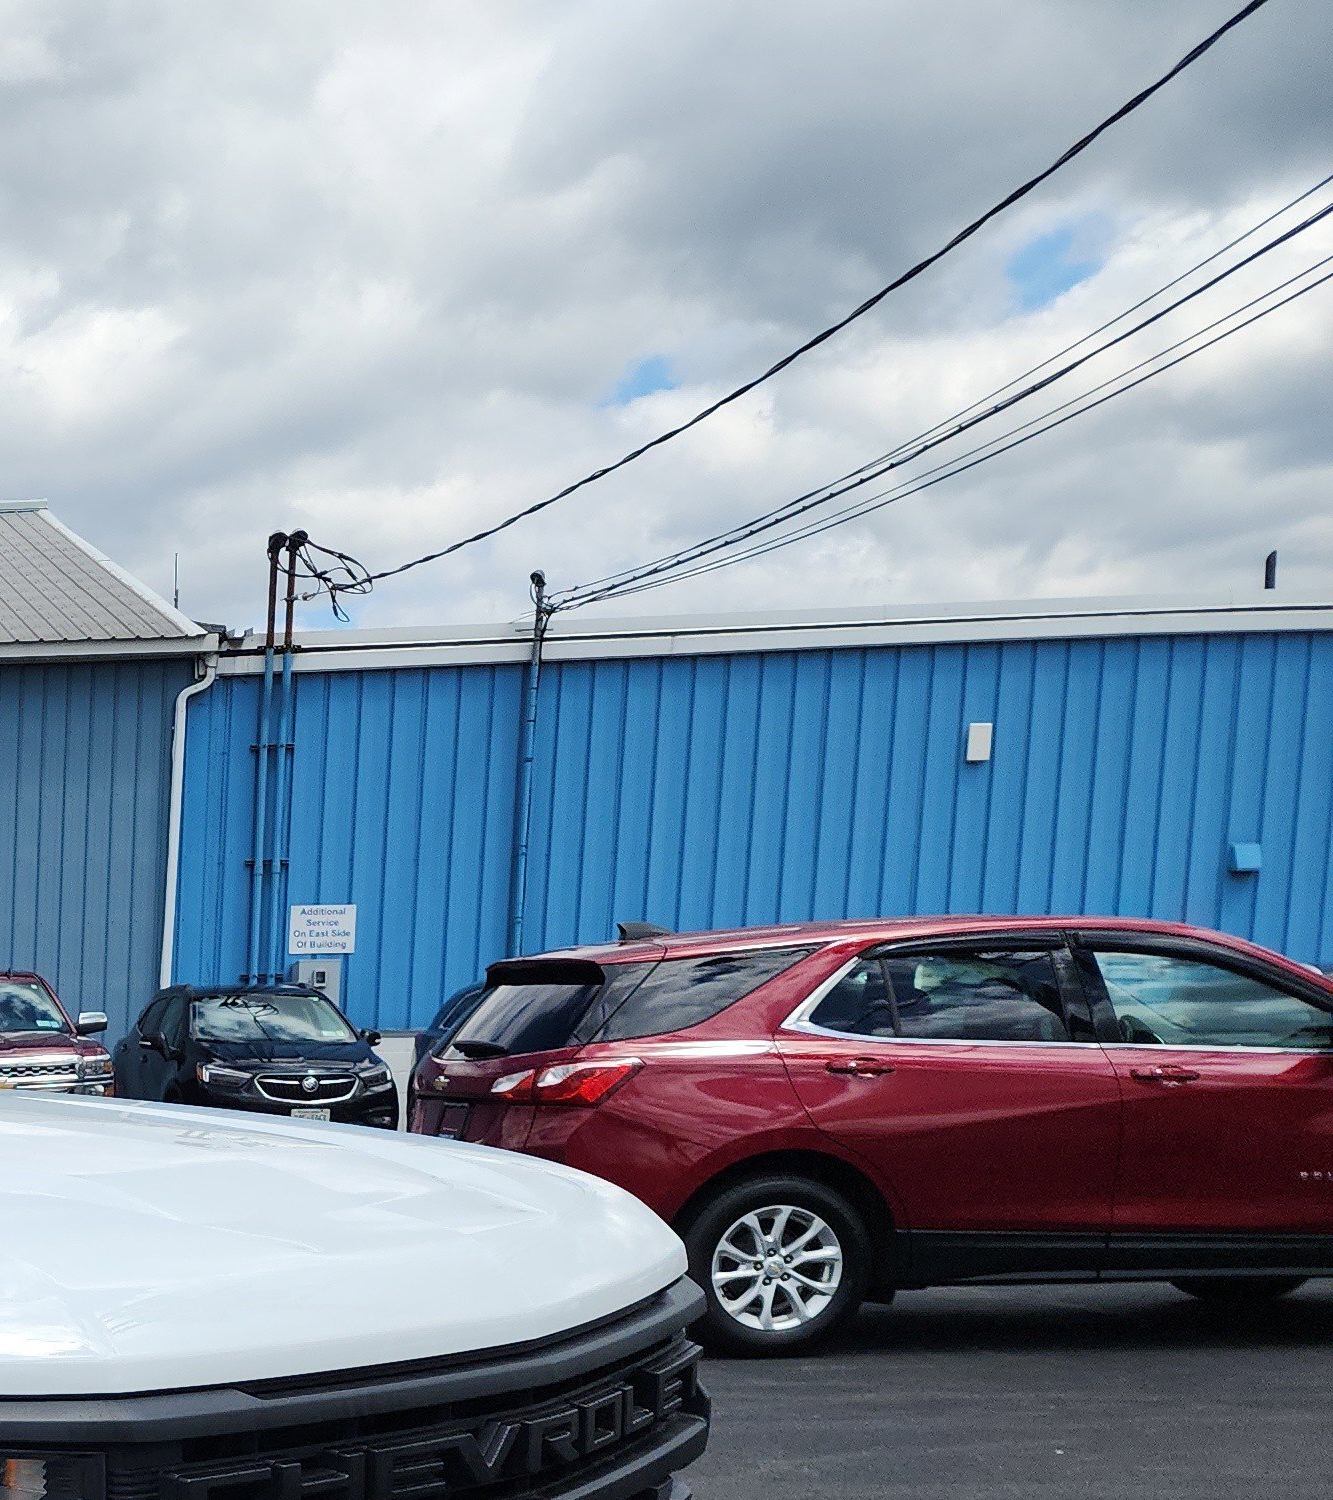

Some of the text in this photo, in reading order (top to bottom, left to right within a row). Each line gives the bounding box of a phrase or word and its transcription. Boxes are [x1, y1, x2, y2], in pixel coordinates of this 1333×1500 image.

[305, 919, 340, 927] Service
[293, 930, 351, 938] On East Side
[309, 941, 347, 950] Building
